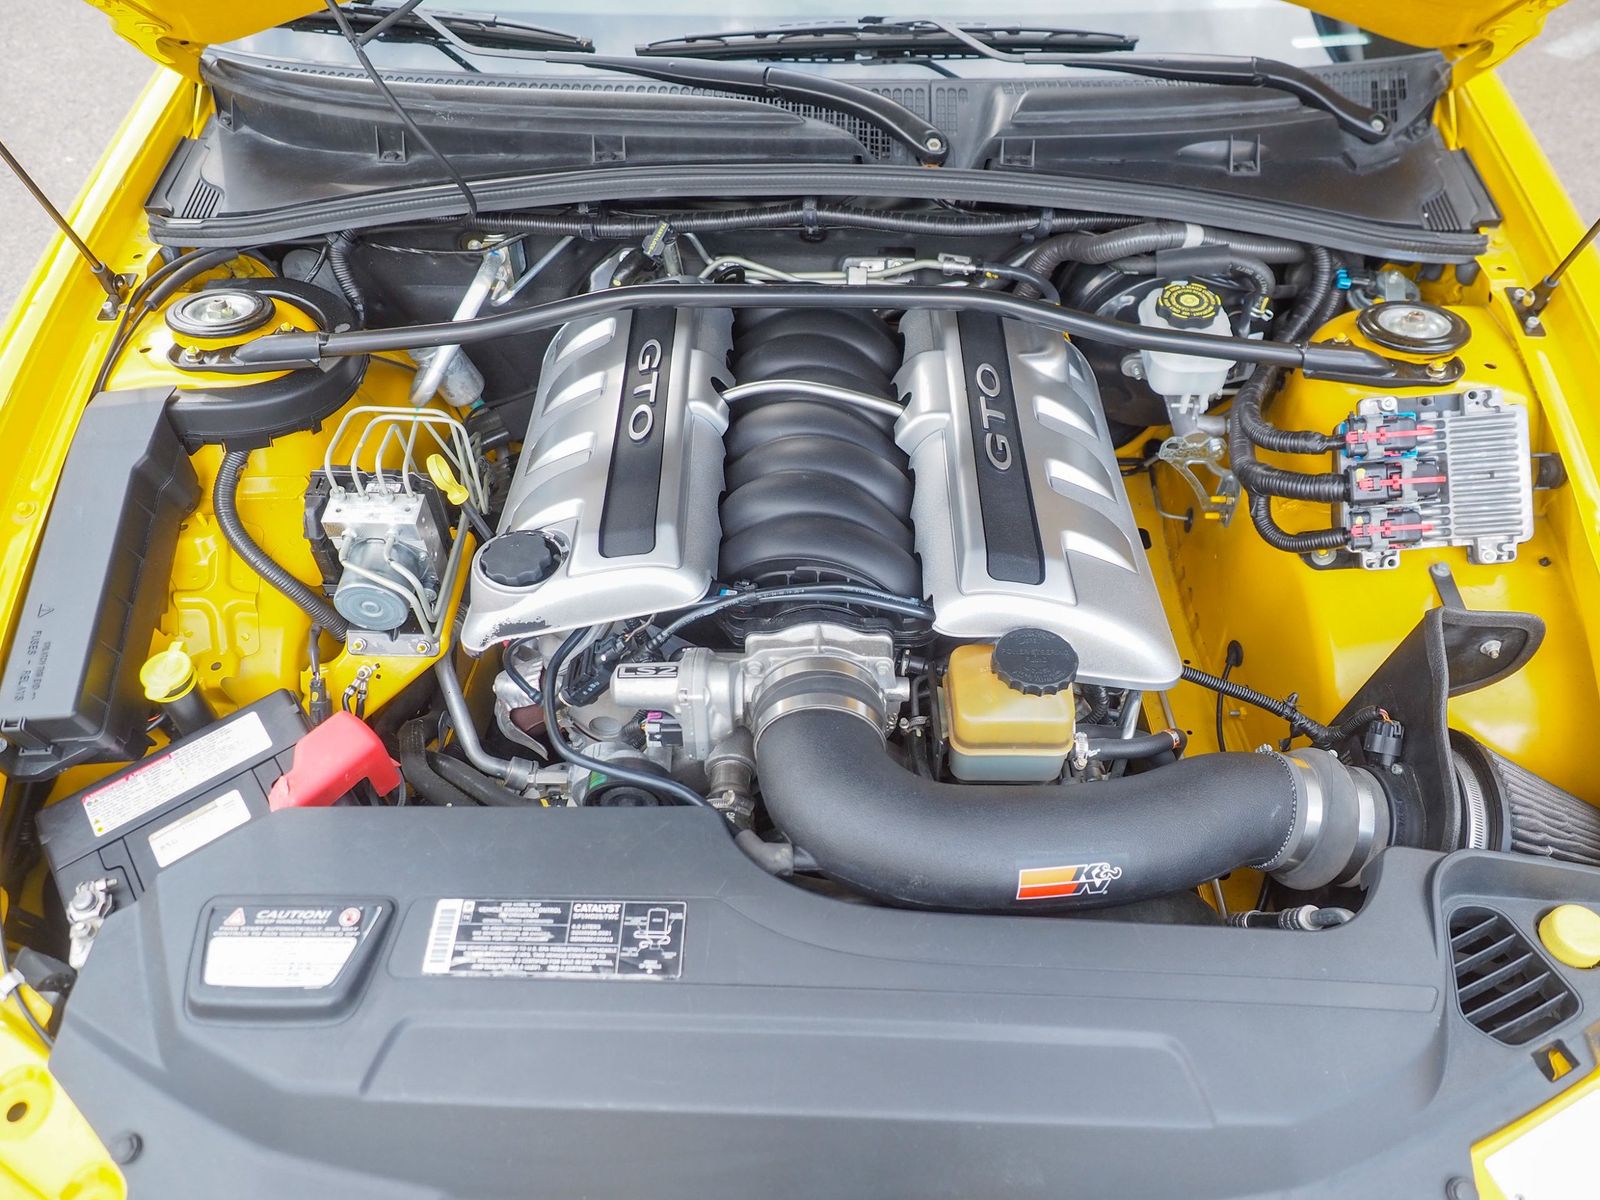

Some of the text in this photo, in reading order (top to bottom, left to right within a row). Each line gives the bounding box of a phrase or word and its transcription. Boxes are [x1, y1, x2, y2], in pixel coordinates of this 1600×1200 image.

[627, 338, 663, 443] GTO
[975, 362, 1012, 472] GTO
[27, 630, 42, 655] FUSES
[618, 665, 678, 677] LS2
[256, 910, 333, 920] CAUTION!
[573, 903, 621, 913] CATALYST
